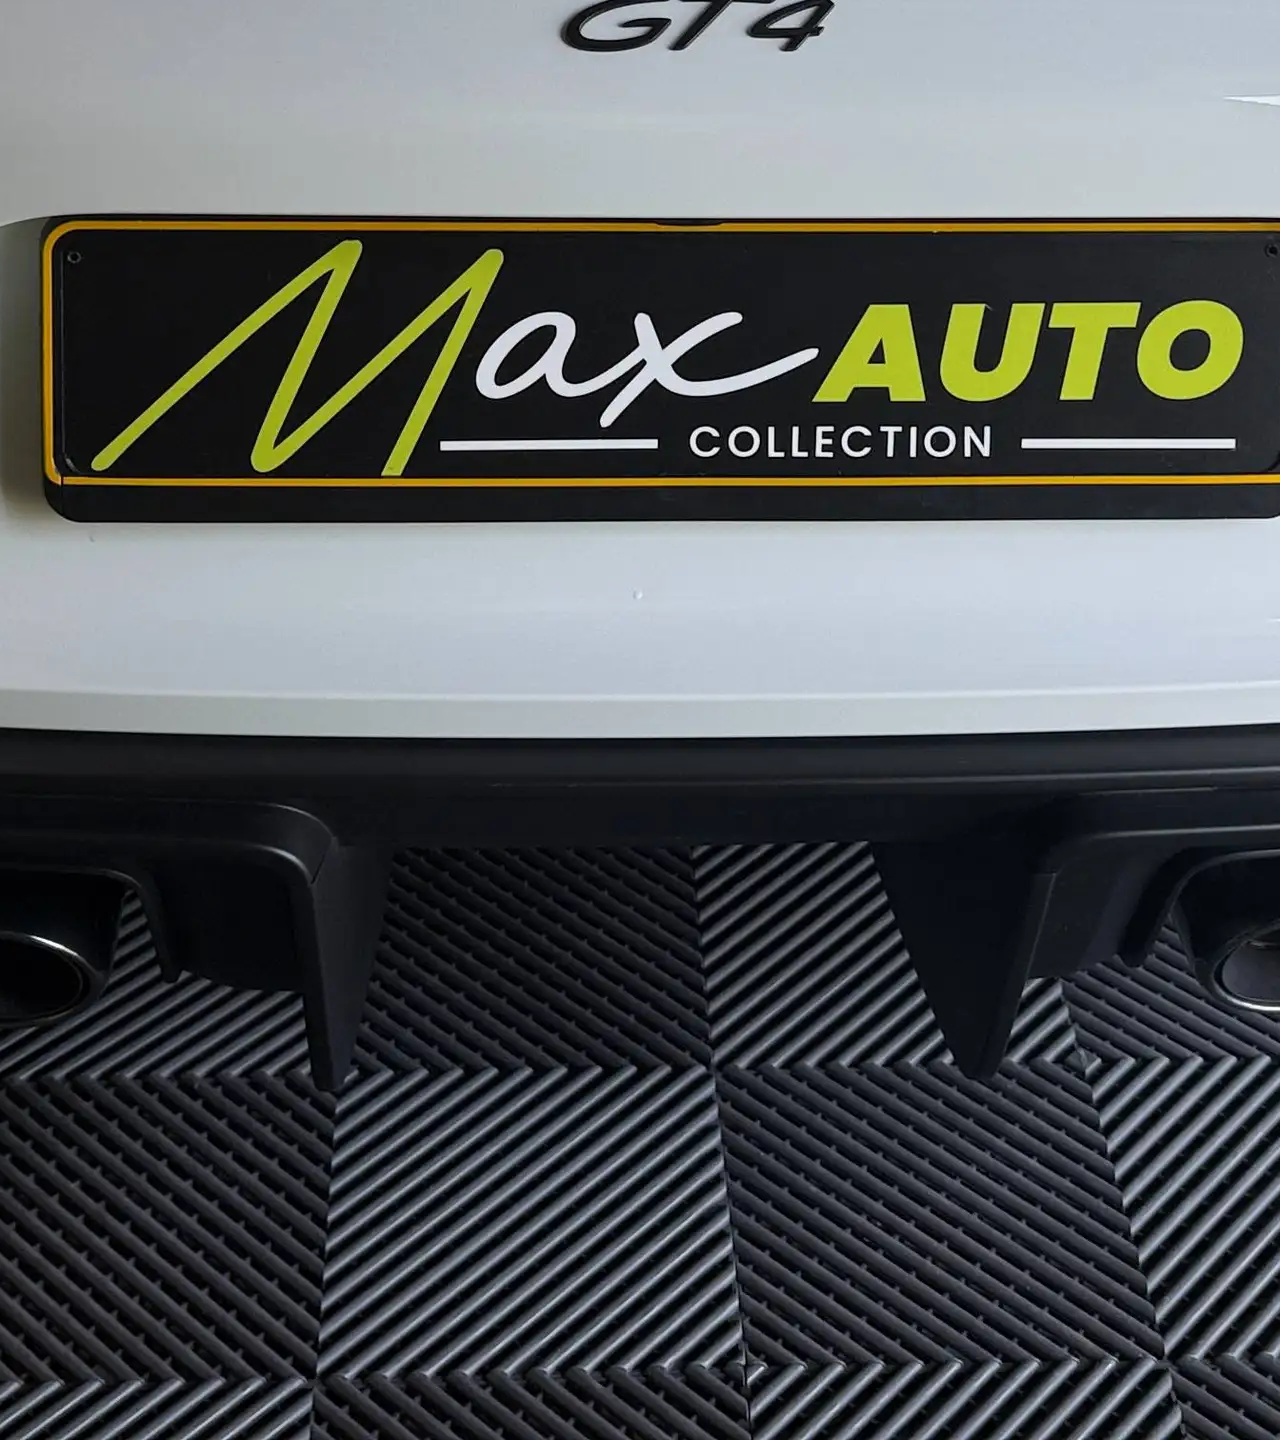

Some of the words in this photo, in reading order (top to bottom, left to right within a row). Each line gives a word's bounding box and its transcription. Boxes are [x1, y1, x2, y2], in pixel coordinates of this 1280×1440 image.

[91, 239, 819, 477] Max
[811, 299, 1244, 402] AUTO
[688, 424, 992, 458] COLLECTION
